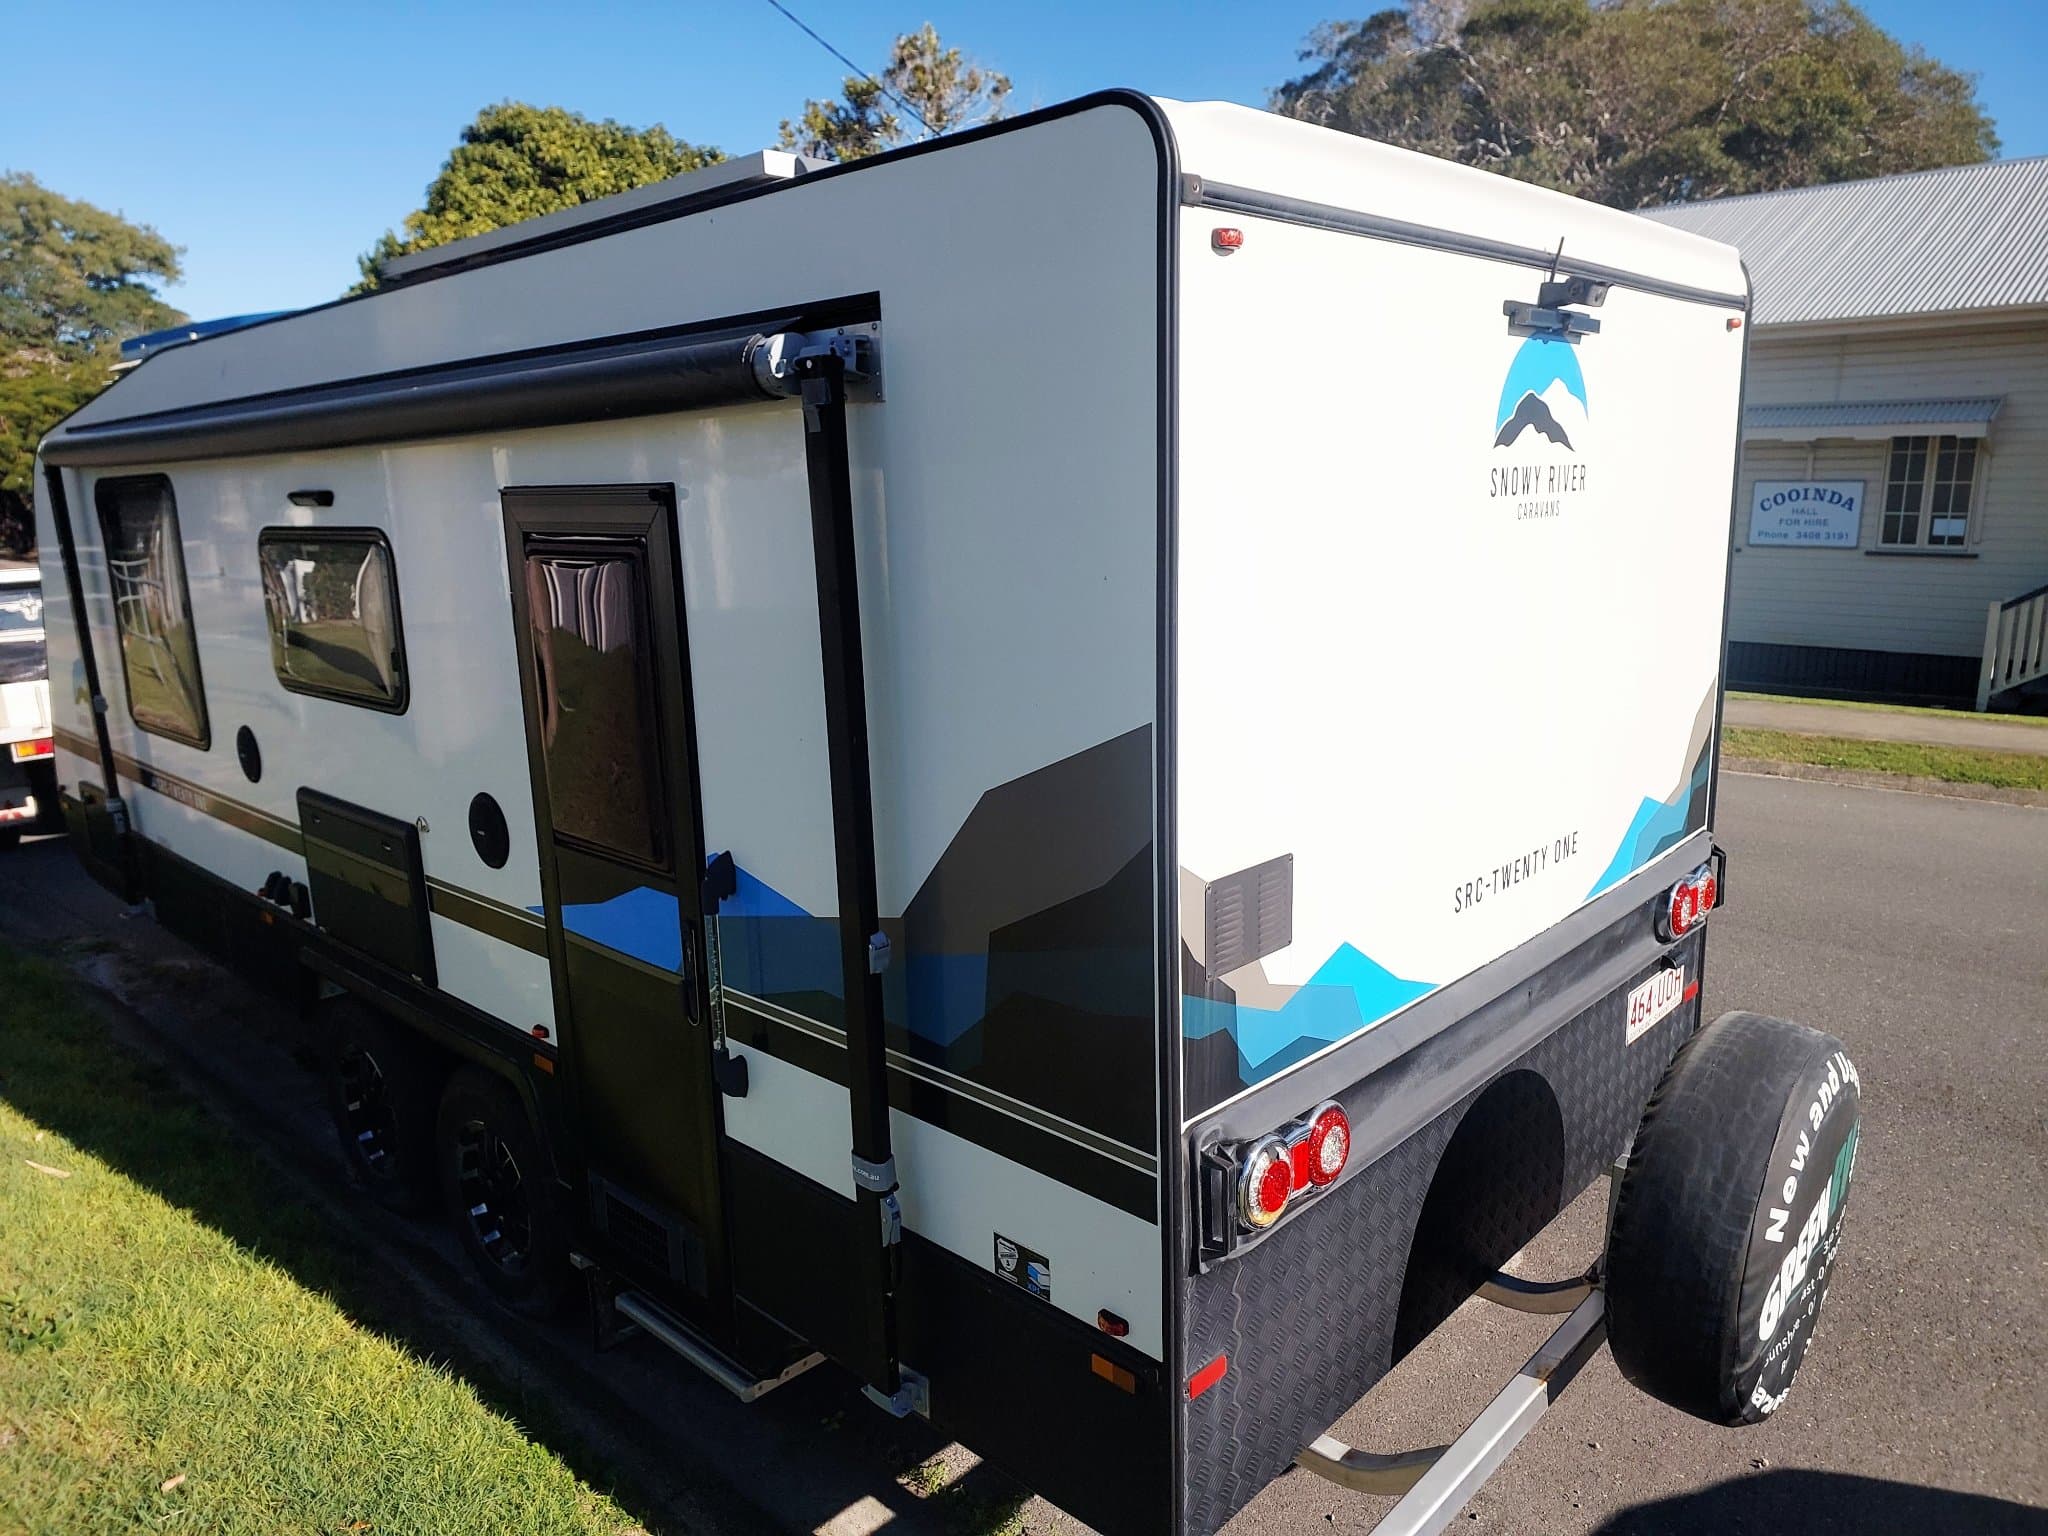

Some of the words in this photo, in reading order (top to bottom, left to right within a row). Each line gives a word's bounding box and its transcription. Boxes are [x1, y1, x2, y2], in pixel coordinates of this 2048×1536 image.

[1490, 466, 1541, 497] SNOWY
[1549, 464, 1586, 493] RIVER
[1518, 500, 1560, 520] CARAVANS
[1760, 487, 1855, 512] COOINDA
[1792, 507, 1819, 516] HALL
[1757, 530, 1789, 540] Phone
[1779, 518, 1801, 527] FOR
[1804, 518, 1830, 527] HIRE
[1455, 845, 1548, 914] SRC-TWENTY
[1554, 831, 1578, 864] ONE
[1764, 1129, 1811, 1243] New
[1809, 1059, 1841, 1132] and
[1758, 1173, 1834, 1342] GREEN
